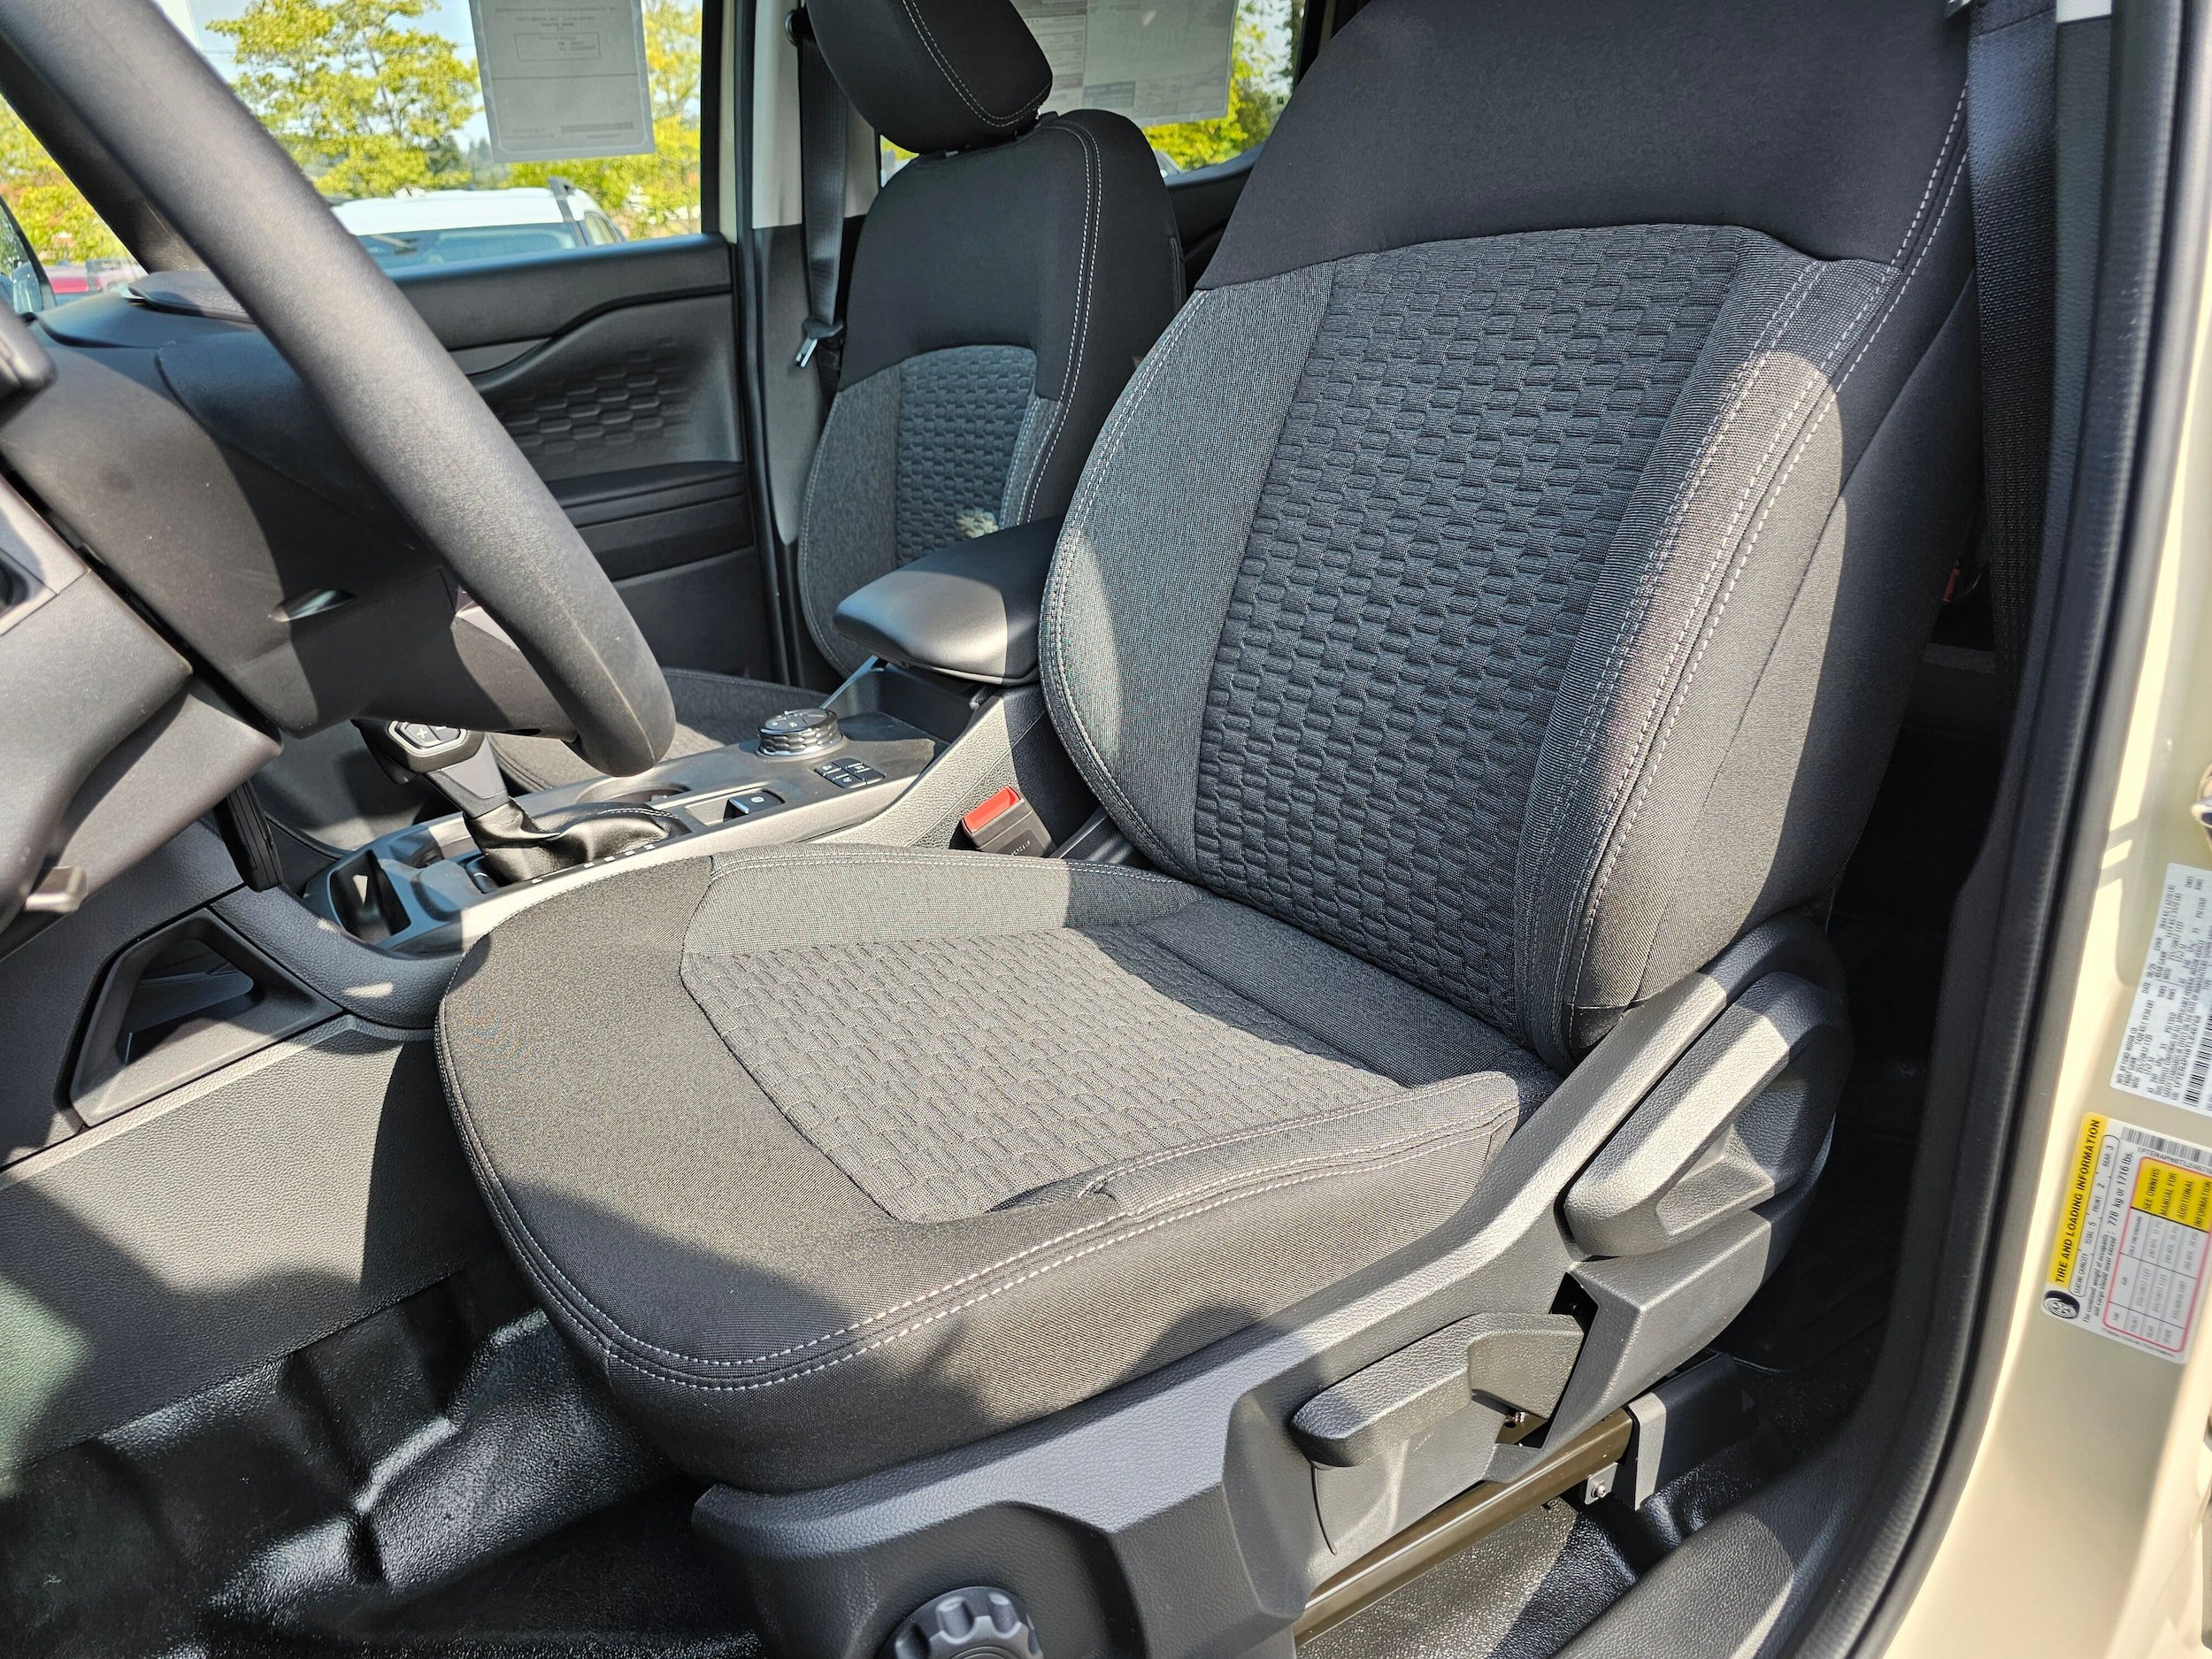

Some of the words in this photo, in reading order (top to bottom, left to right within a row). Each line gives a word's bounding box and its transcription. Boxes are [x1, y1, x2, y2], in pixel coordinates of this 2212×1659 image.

[2075, 1118, 2101, 1191] INFORMATION
[2116, 1164, 2129, 1186] 1716
[2146, 1166, 2161, 1197] OWNERS
[2111, 1196, 2124, 1210] kg
[2117, 1187, 2124, 1197] or
[2159, 1187, 2173, 1217] MANUAL
[2166, 1171, 2177, 1187] FOR
[2176, 1179, 2193, 1220] ADDITIONAL
[2142, 1196, 2154, 1211] SEE
[2193, 1179, 2212, 1229] INFORMATION
[2065, 1193, 2084, 1238] LOADING
[2107, 1210, 2119, 1227] 778
[2084, 1230, 2093, 1245] TOTAL
[2061, 1238, 2073, 1260] AND
[2055, 1260, 2069, 1284] TIRE
[2077, 1252, 2089, 1276] CAPACITY
[2073, 1274, 2084, 1294] SEATING
[2091, 1268, 2102, 1287] weight
[2085, 1286, 2097, 1313] combined
[2095, 1290, 2106, 1307] cargo
[2082, 1313, 2091, 1324] The
